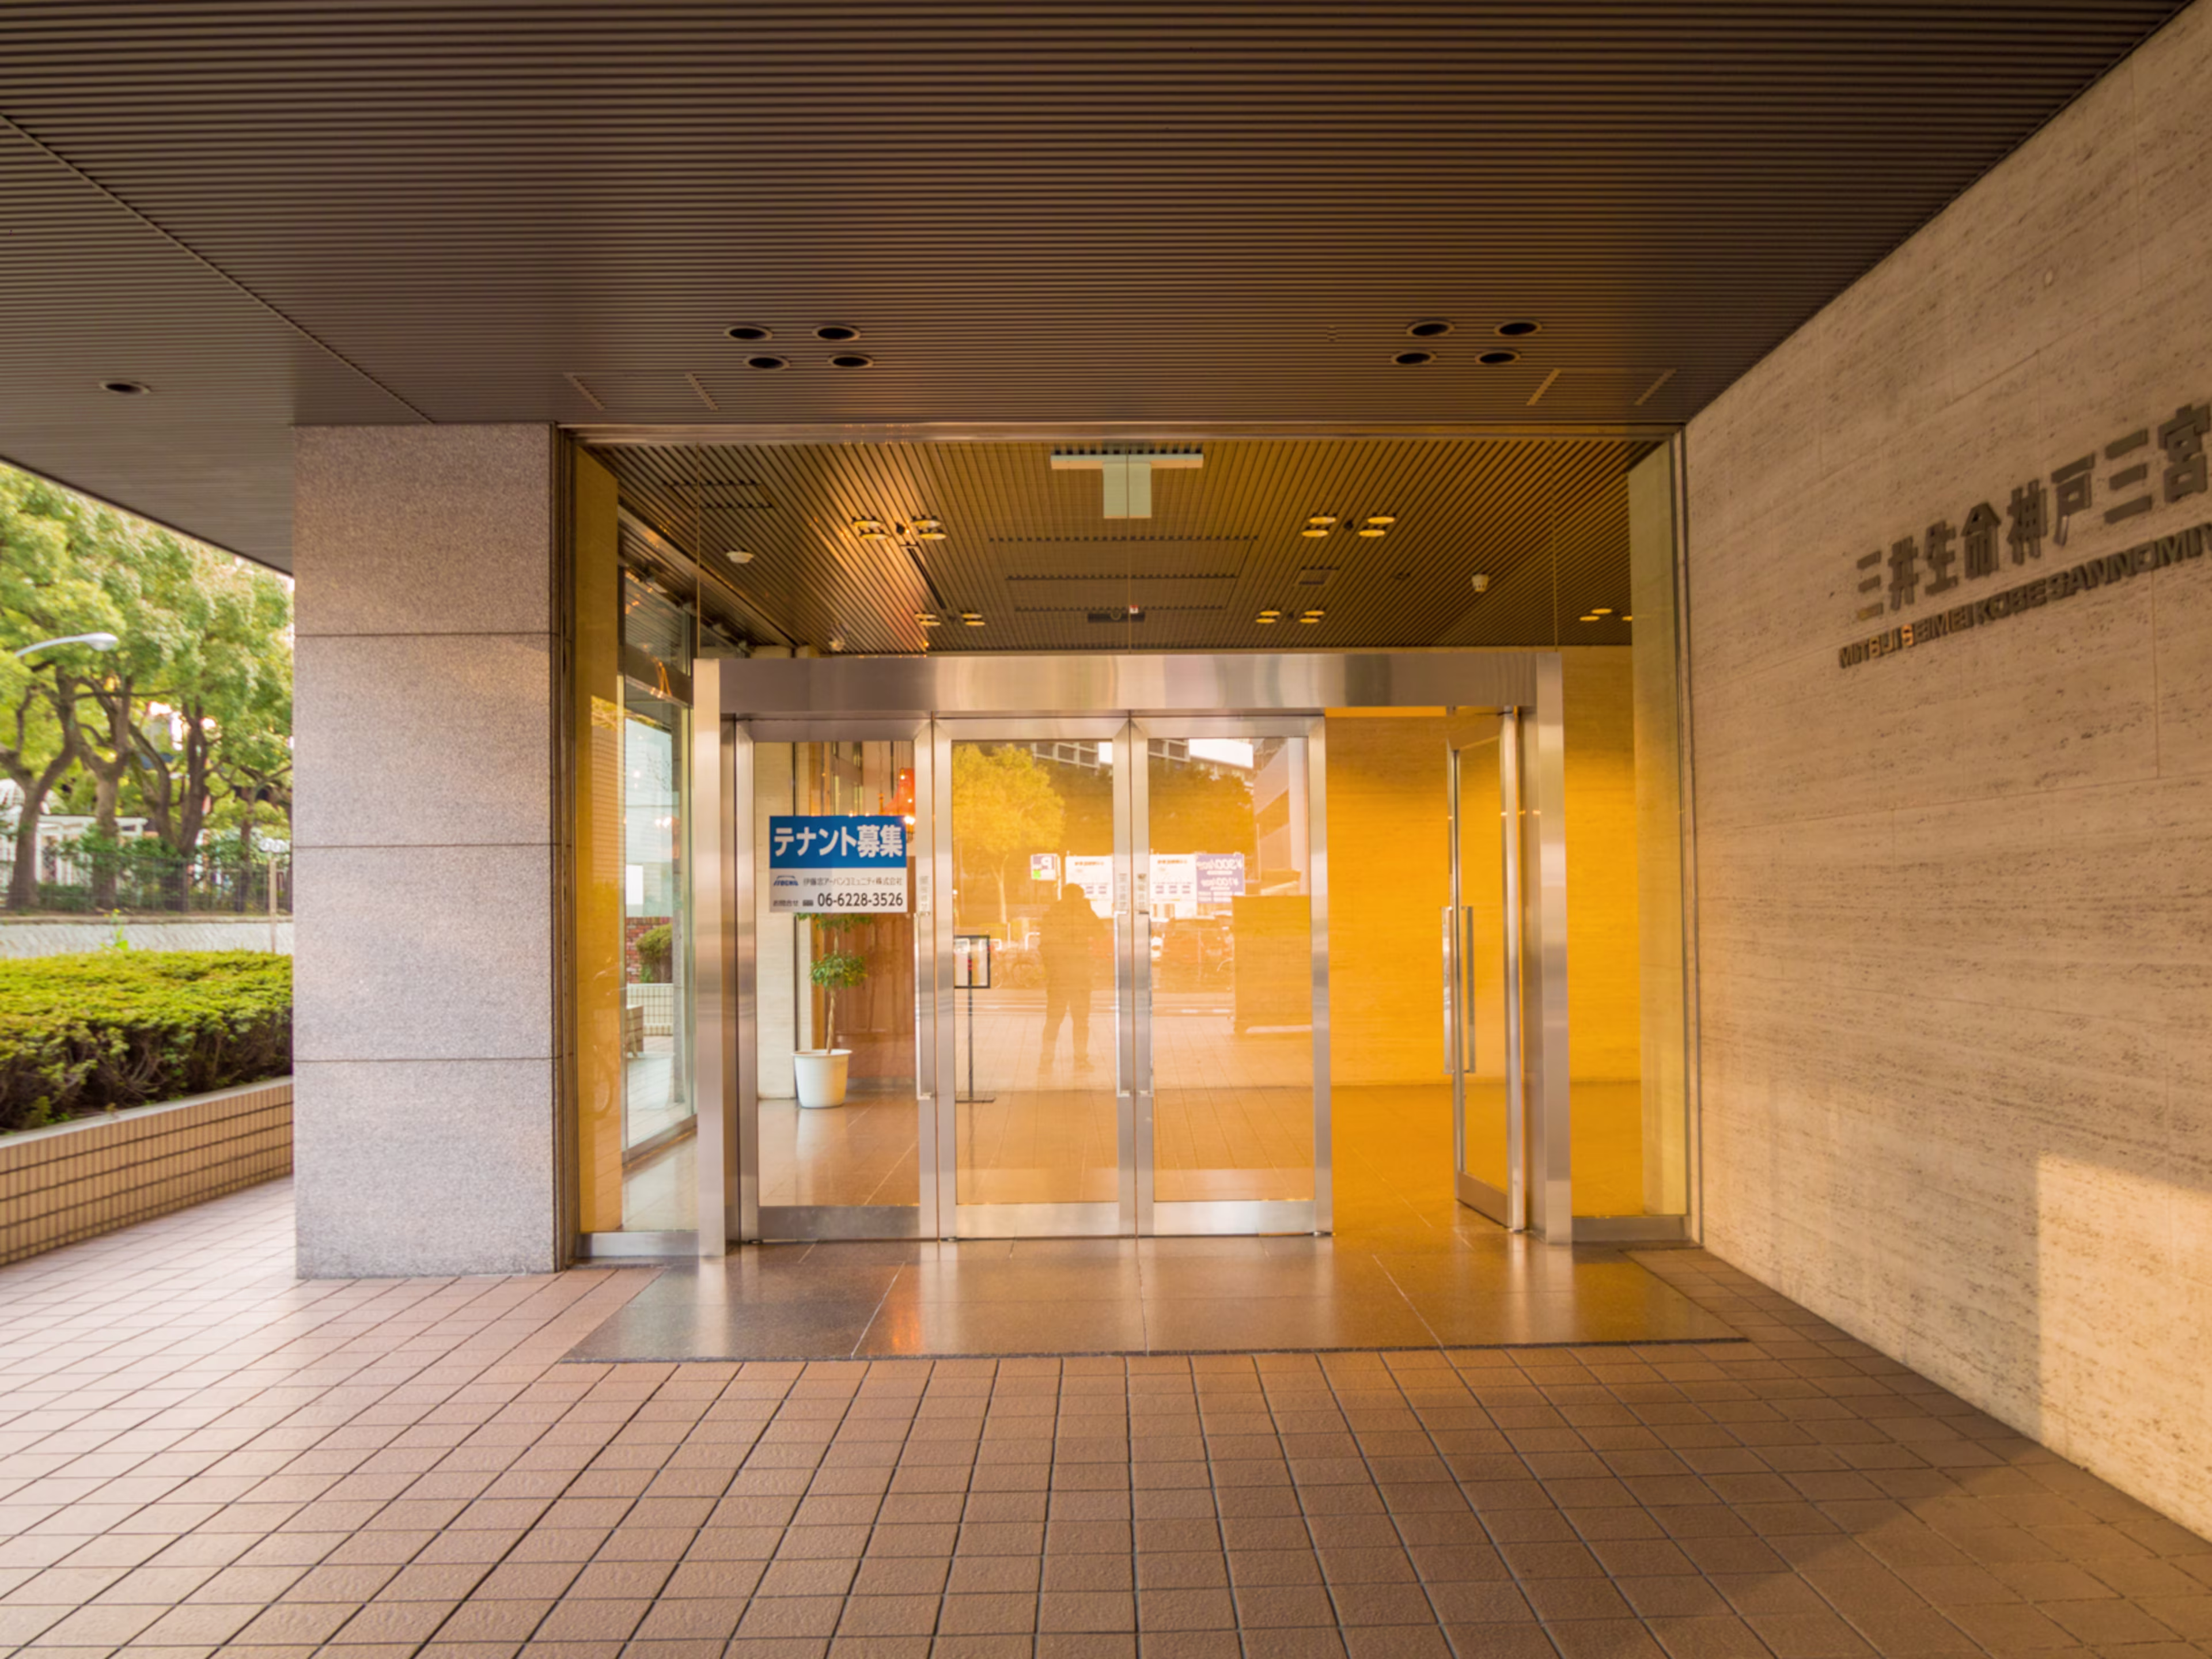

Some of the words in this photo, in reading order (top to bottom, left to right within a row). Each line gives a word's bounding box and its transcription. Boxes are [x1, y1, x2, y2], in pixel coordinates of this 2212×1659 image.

[1856, 403, 2211, 620] 三井生命神戸三宮
[1839, 627, 1902, 669] MITSUI
[1902, 603, 1974, 647] SEIMEI
[1974, 578, 2047, 625] KOBE
[774, 824, 903, 858] テナント募集
[817, 892, 903, 907] 06-6228-3526
